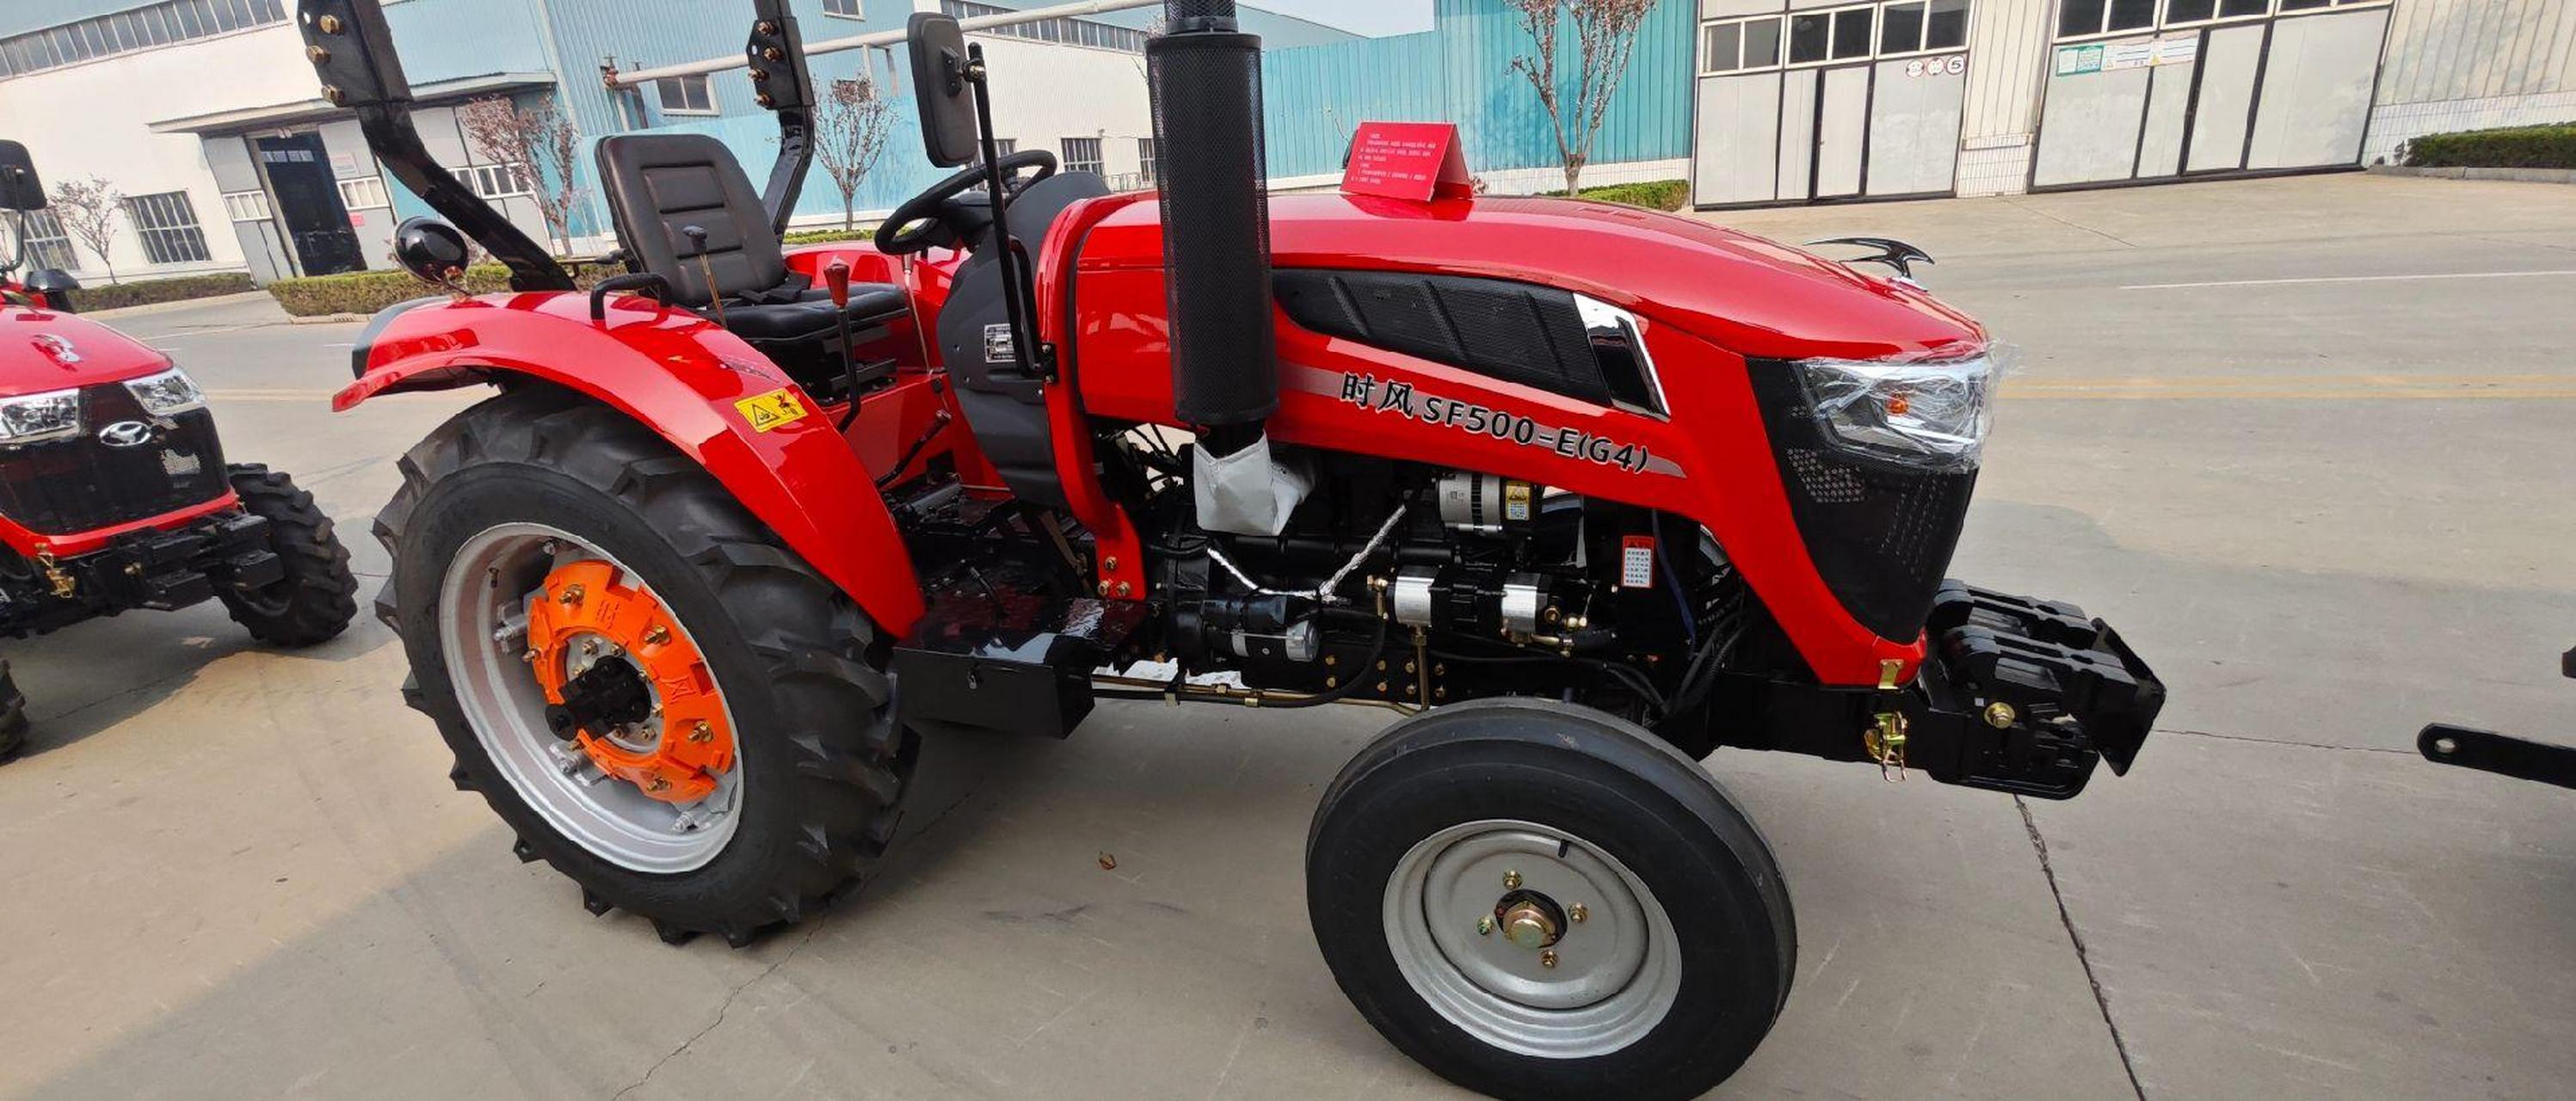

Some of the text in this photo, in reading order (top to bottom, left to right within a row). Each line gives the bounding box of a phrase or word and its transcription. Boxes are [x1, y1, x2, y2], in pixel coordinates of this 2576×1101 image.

[1951, 59, 1962, 70] 5
[1340, 372, 1648, 473] 时风 SF500-E(G4)
